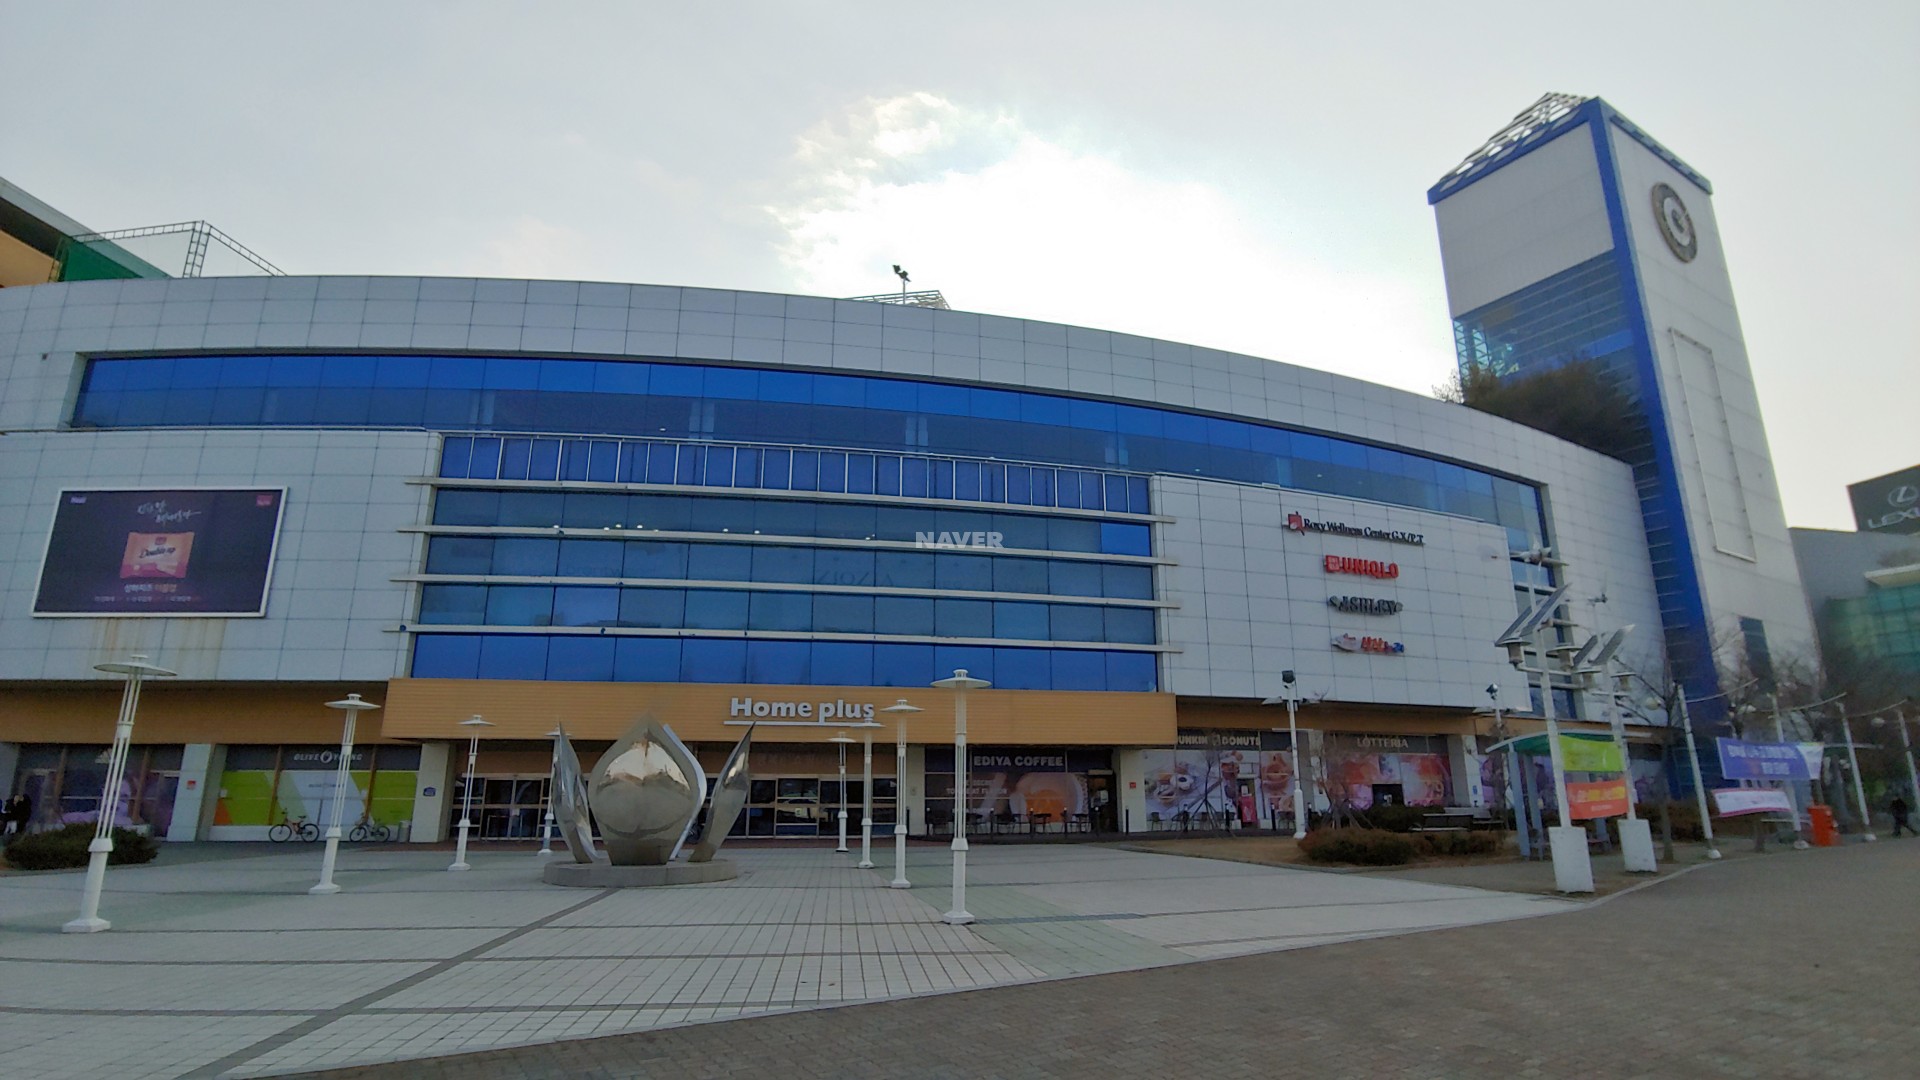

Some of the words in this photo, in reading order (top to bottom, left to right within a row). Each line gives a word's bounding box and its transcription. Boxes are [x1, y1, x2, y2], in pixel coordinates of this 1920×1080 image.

[1303, 518, 1326, 531] Roxy
[1326, 521, 1363, 537] Wellness
[1363, 526, 1392, 540] Center
[1341, 556, 1399, 580] UNIQLO
[1338, 595, 1397, 616] ASHLEY
[730, 697, 813, 718] Home
[818, 699, 875, 725] plus
[1176, 735, 1208, 745] UNKIN
[1356, 737, 1409, 749] LOTTERIA
[973, 755, 1012, 767] EDIYA
[1014, 756, 1064, 767] COFFEE
